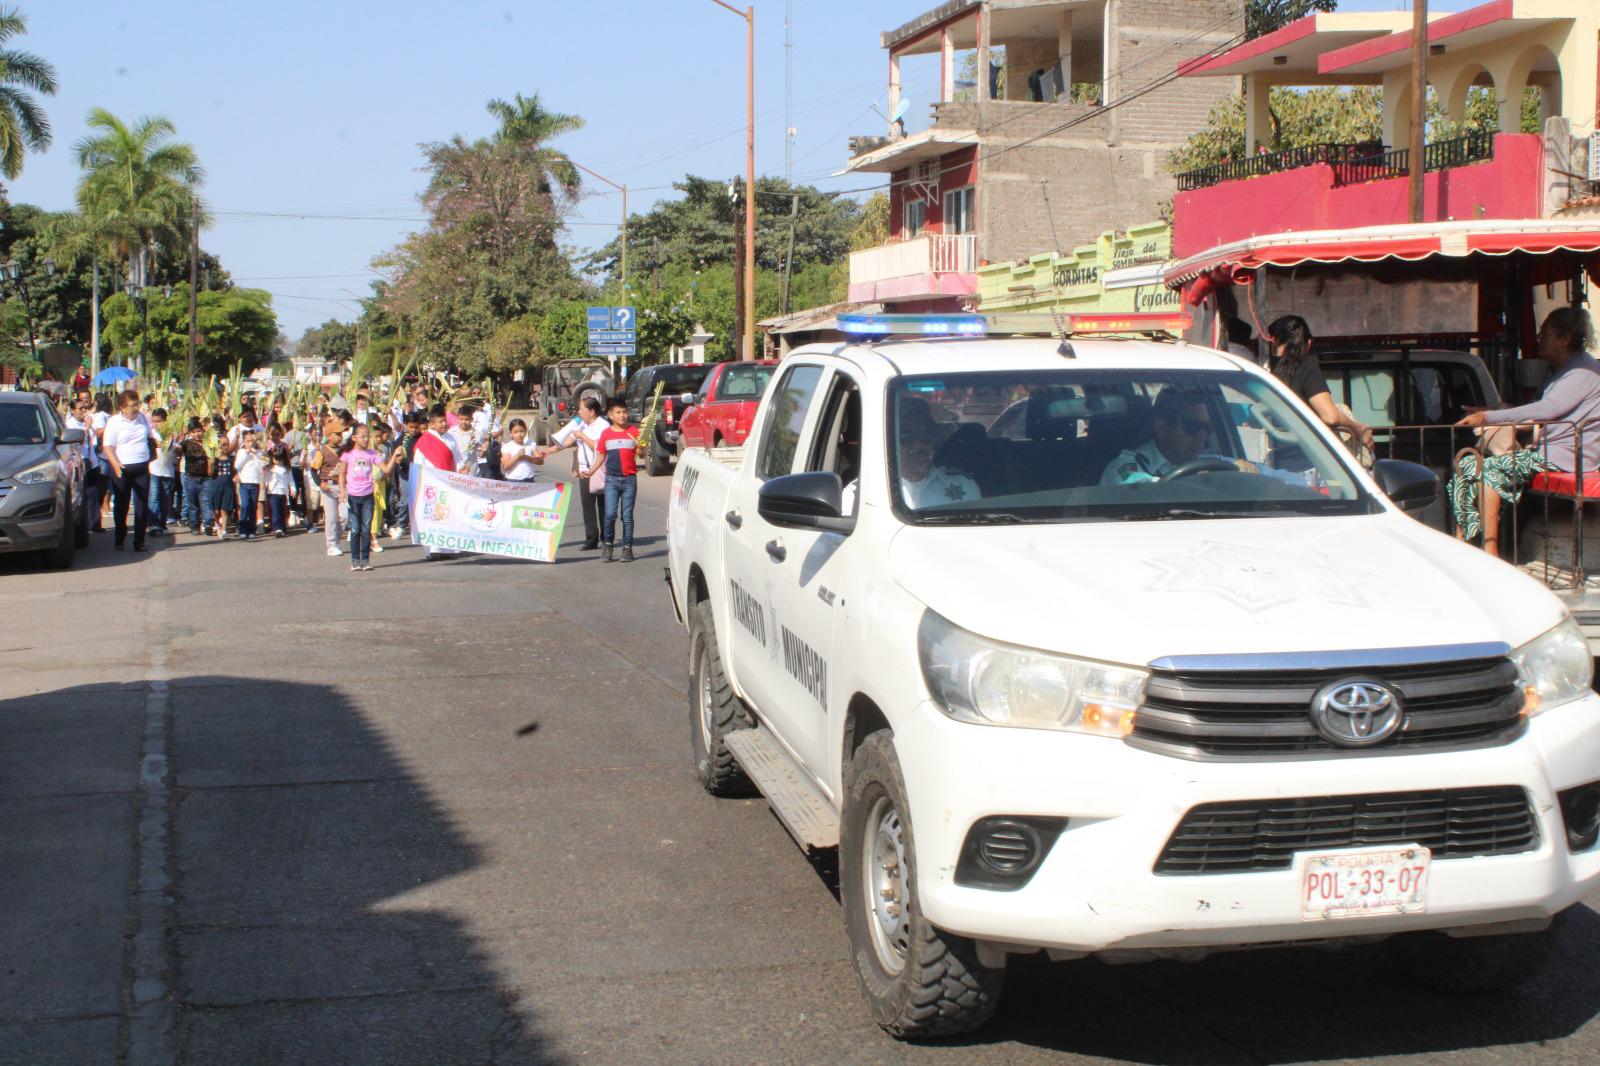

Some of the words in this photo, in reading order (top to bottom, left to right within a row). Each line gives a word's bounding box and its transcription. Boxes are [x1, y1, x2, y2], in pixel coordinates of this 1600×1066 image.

[1143, 242, 1157, 253] del
[1053, 267, 1098, 288] GORDITAS
[418, 532, 476, 550] PASCUA
[481, 541, 547, 560] INFANTIL
[781, 624, 827, 714] MUNICIPAL
